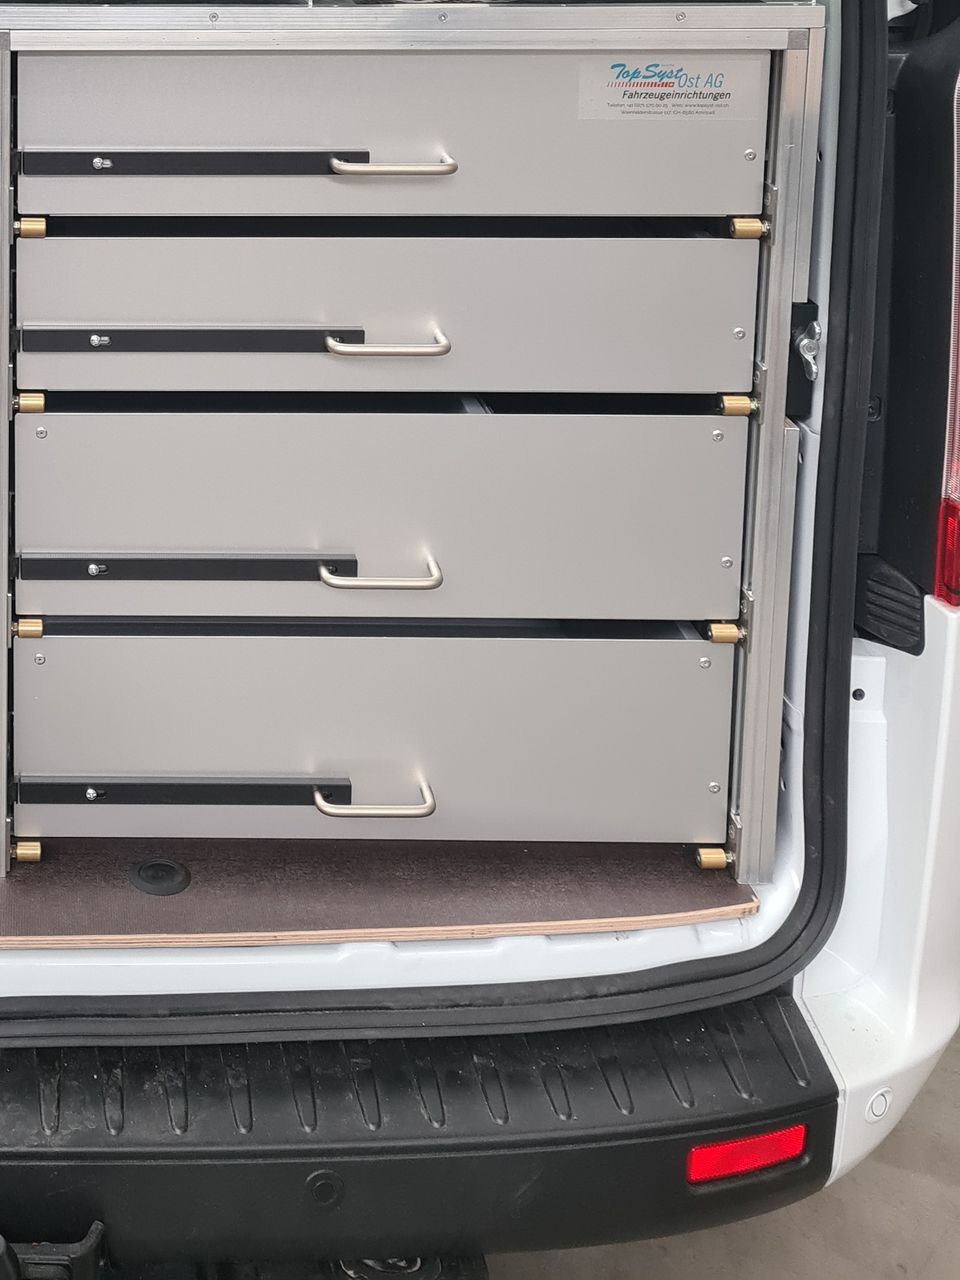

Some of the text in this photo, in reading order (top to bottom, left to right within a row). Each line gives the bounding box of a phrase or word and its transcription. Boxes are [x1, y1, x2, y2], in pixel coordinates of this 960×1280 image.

[677, 73, 701, 88] Ost
[704, 73, 725, 88] AG
[622, 90, 731, 101] Fahrzeugeinrichtungen
